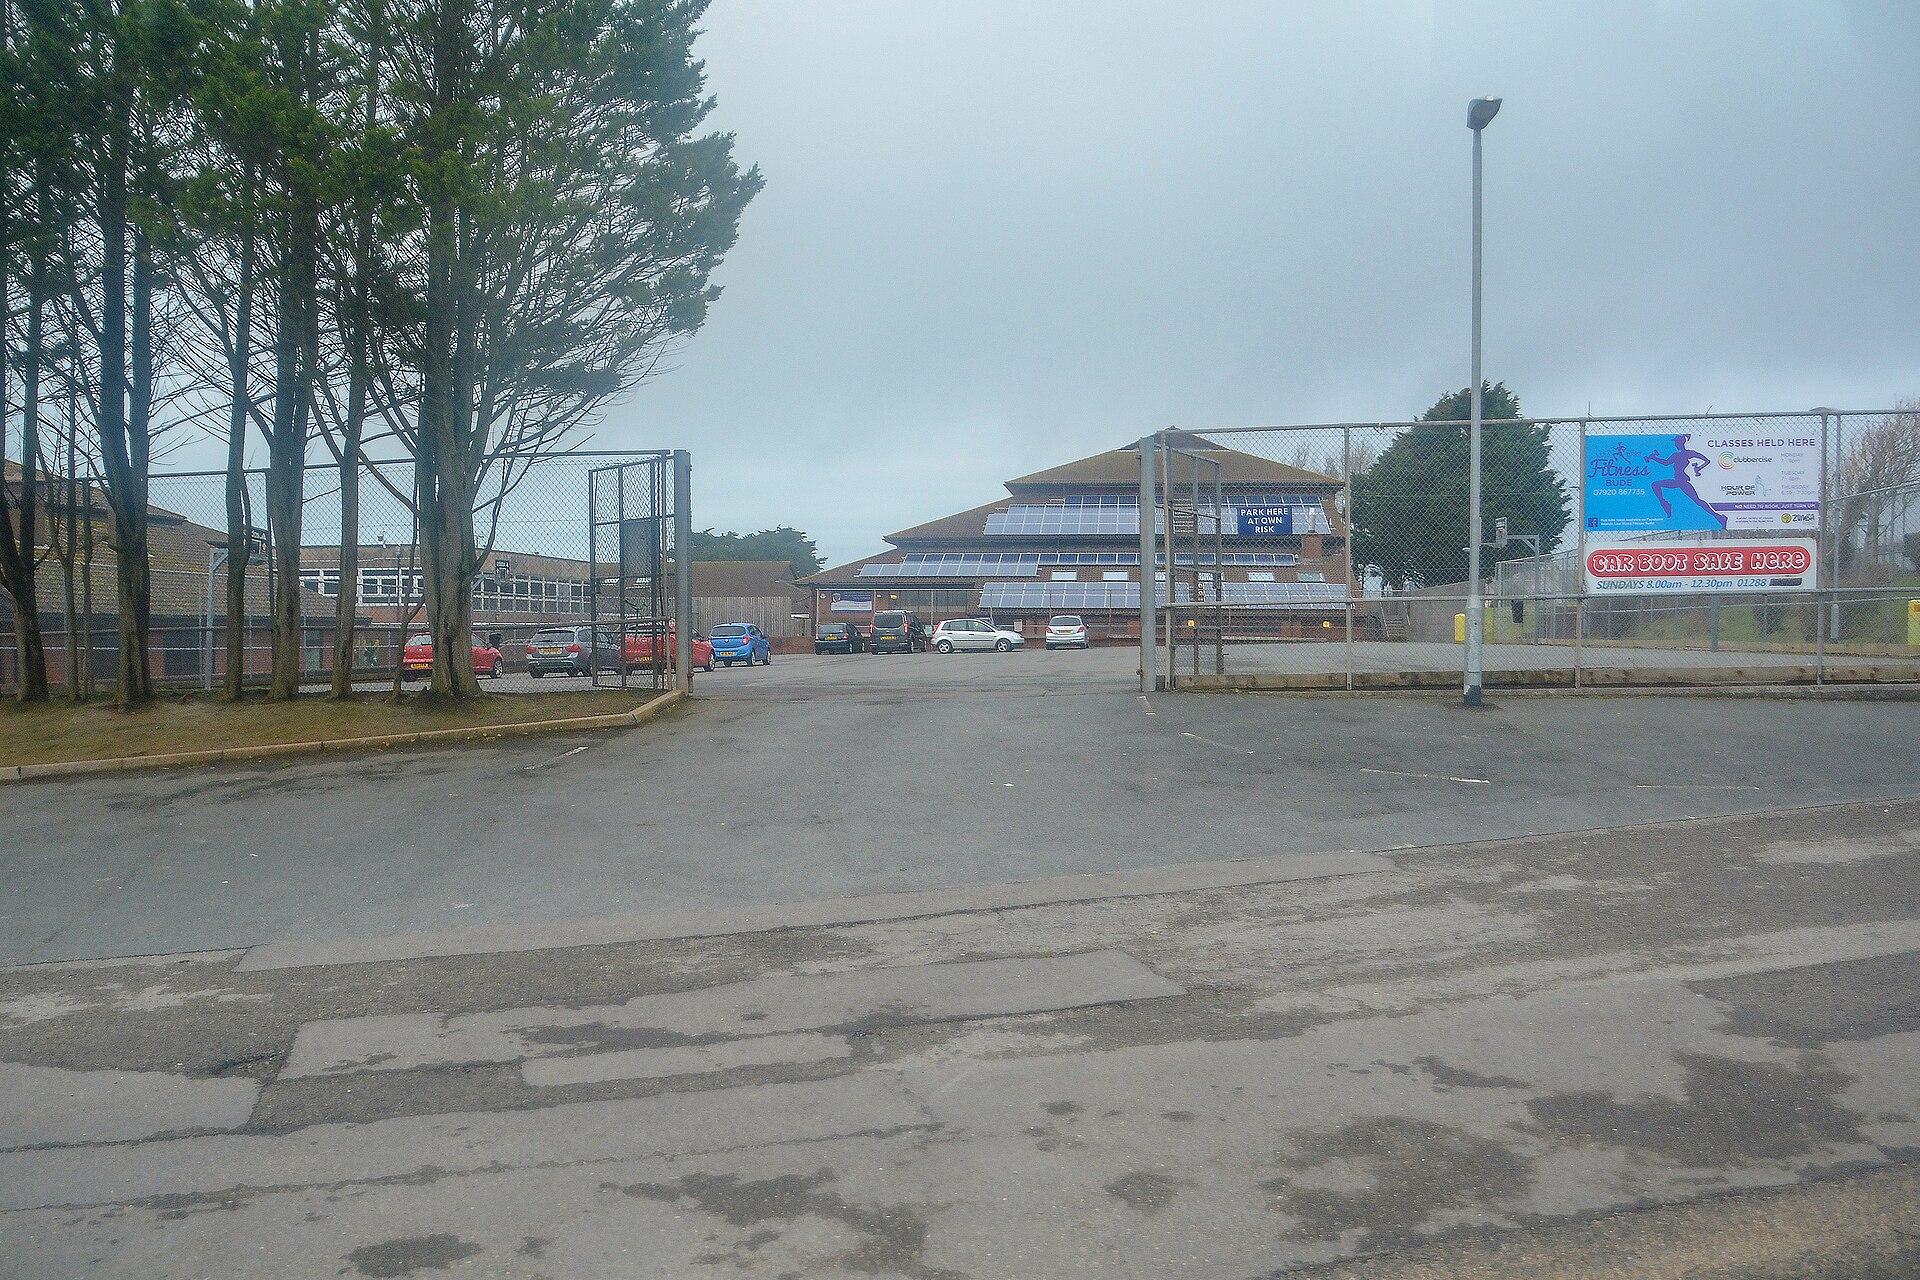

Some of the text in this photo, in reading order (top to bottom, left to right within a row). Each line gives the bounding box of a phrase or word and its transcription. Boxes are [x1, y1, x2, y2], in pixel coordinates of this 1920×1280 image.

[1707, 438, 1815, 448] CLASSES HELD HERE
[1588, 458, 1651, 478] Fitness
[1605, 479, 1633, 487] BUDE
[1592, 554, 1633, 572] CAR
[1637, 553, 1687, 571] BOOT
[1692, 552, 1742, 570] SALE
[1595, 580, 1644, 590] SUNDAYS
[1645, 579, 1682, 589] 8.00am
[1690, 579, 1732, 590] 12.30pm
[1736, 579, 1767, 588] 01288
